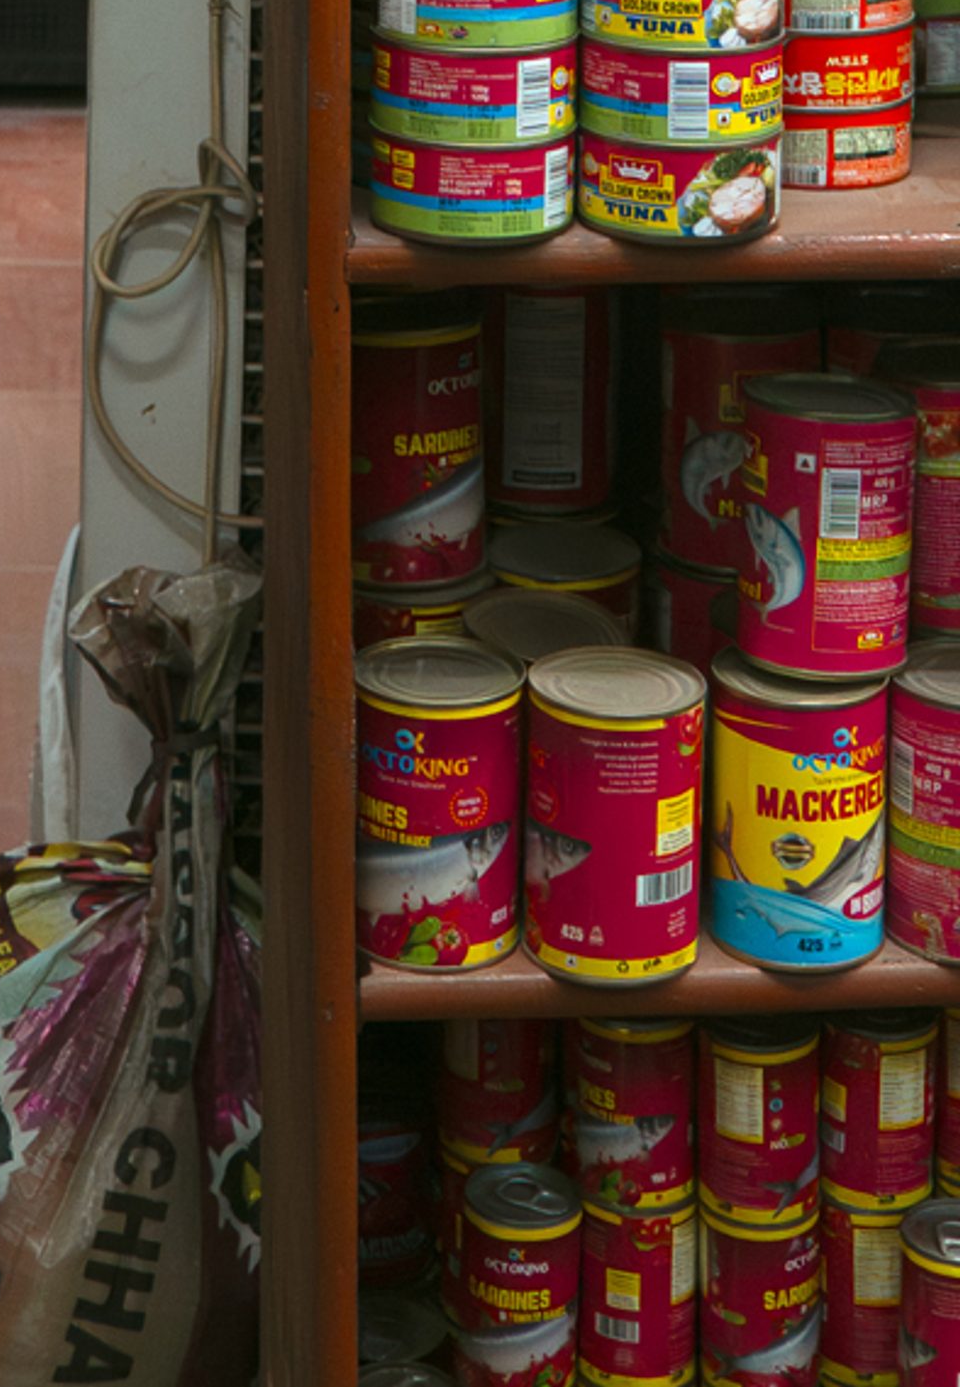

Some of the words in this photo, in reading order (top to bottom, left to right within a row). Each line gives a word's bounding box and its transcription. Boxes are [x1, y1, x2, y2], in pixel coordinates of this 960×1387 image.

[662, 0, 701, 15] CROWN
[625, 16, 695, 35] TUNA
[825, 54, 870, 67] STEW
[604, 201, 668, 222] TUNA
[361, 743, 470, 781] OCTOKING
[755, 775, 885, 823] MACKEREL
[797, 937, 824, 953] 425
[469, 1272, 552, 1312] SARDINES
